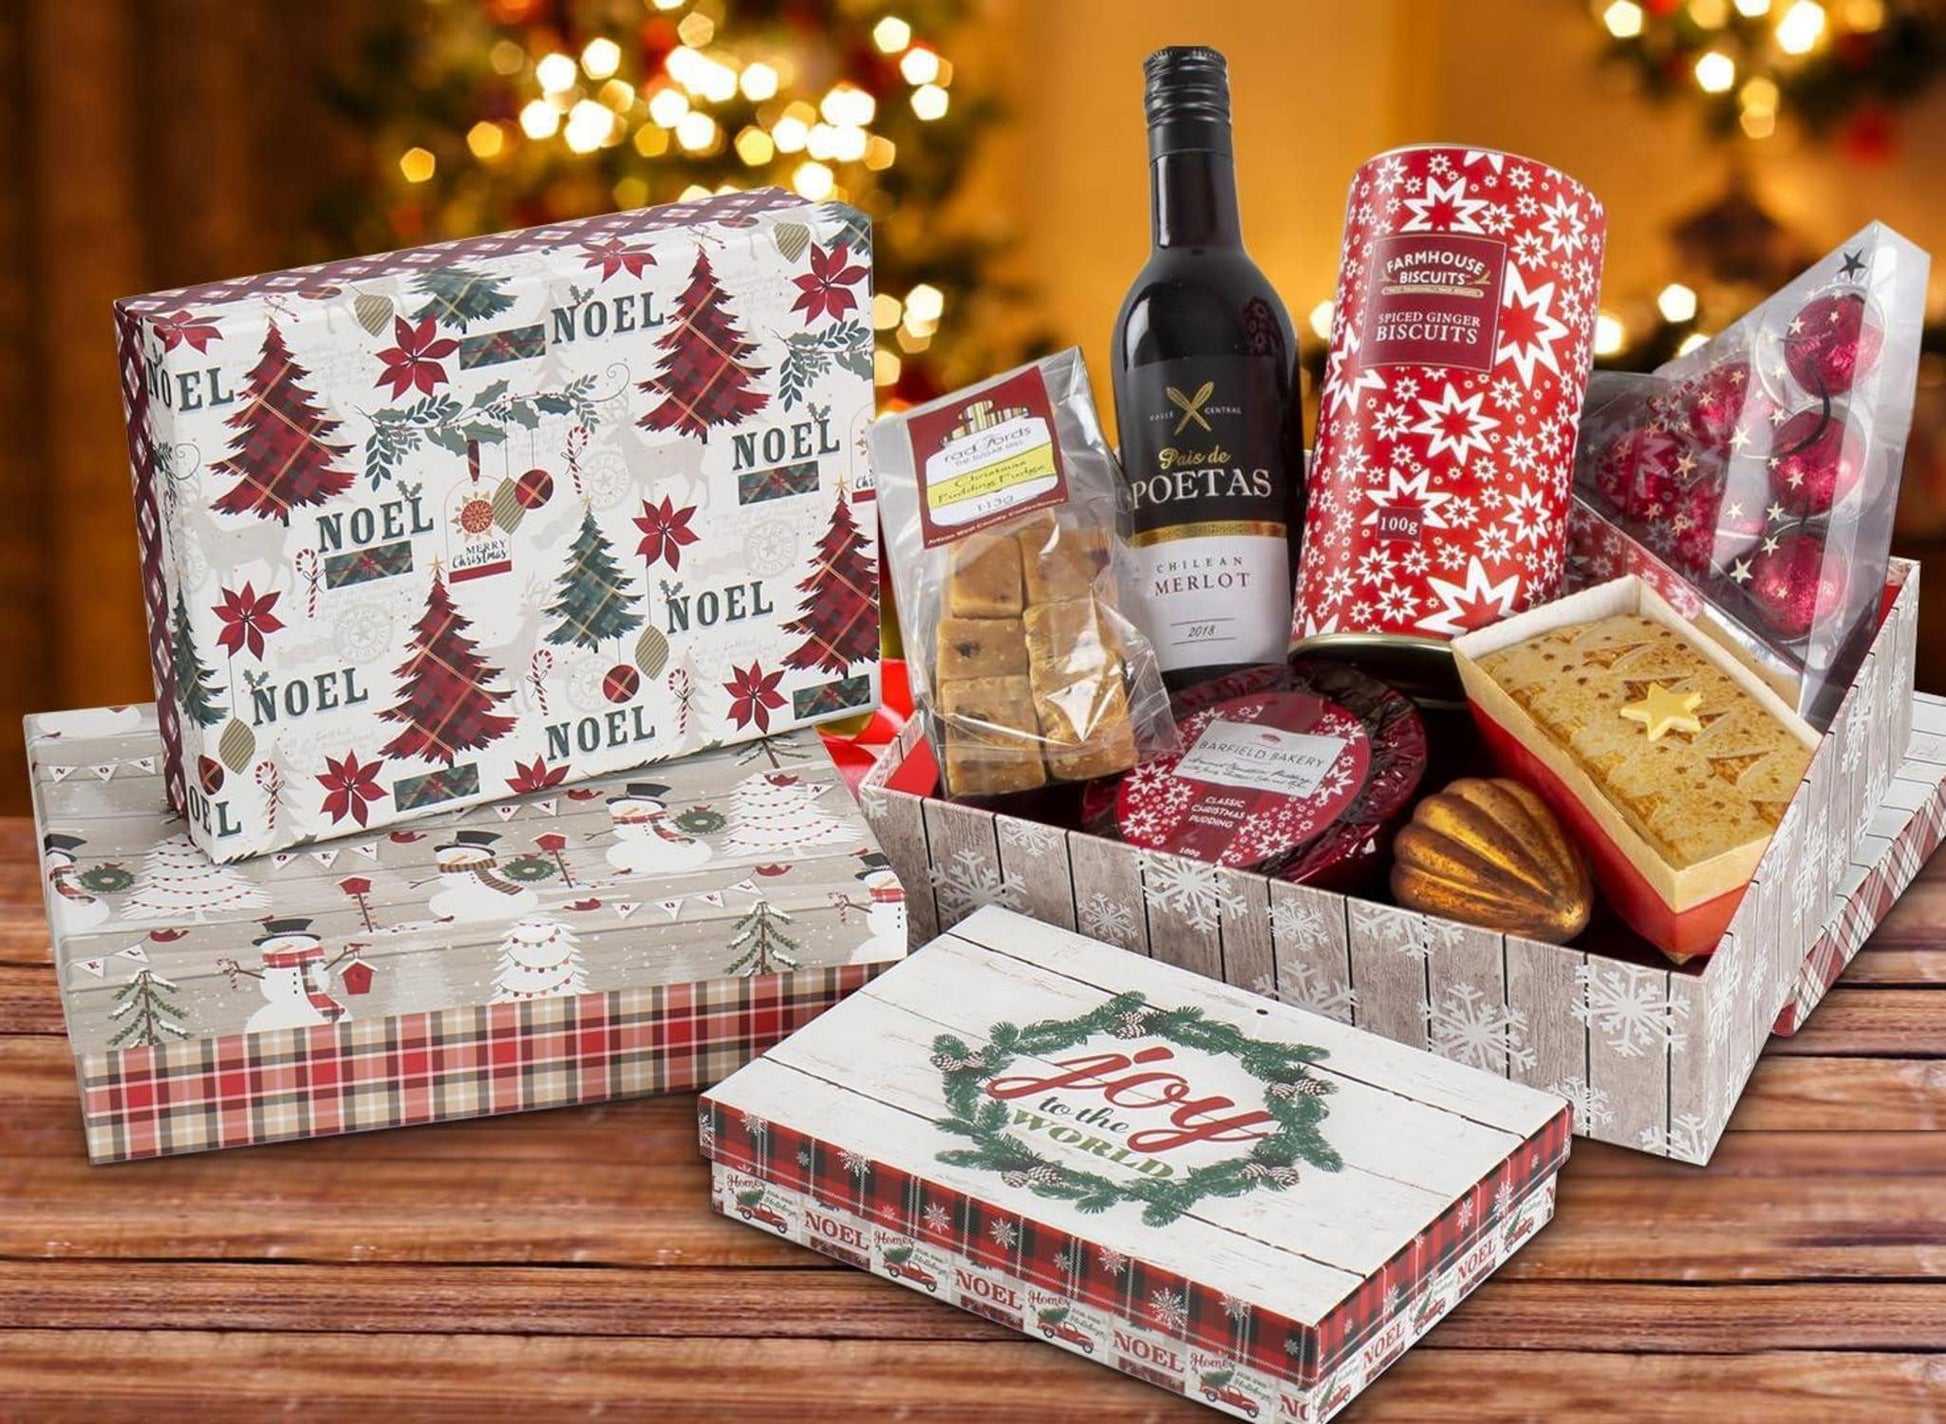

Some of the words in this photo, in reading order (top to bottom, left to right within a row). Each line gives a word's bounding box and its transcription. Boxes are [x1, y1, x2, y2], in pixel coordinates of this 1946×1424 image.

[1386, 250, 1485, 276] FARMHOUSE
[1399, 270, 1466, 286] BISCUITS
[551, 292, 665, 345] NOEL
[1375, 323, 1478, 345] BISCUITS
[1379, 311, 1424, 324] SPICED
[1426, 312, 1481, 328] GINGER
[146, 357, 235, 412] NOEL
[1204, 405, 1242, 415] CENTRAL
[732, 419, 841, 472] NOEL
[1208, 444, 1232, 464] de
[1131, 468, 1273, 510] POETAS
[316, 497, 435, 554] NOEL
[1381, 516, 1419, 536] 100g
[452, 549, 507, 569] Christmas
[465, 539, 507, 555] MERRY
[1156, 556, 1244, 574] CHILEAN
[1154, 571, 1251, 597] MERLOT
[666, 579, 774, 635] NOEL
[1188, 624, 1216, 638] 2018
[253, 667, 369, 727] NOEL
[545, 706, 656, 761] NOEL
[1199, 740, 1267, 760] BARFIELD
[1268, 751, 1326, 769] BAKERY
[189, 785, 242, 838] OEL
[1191, 804, 1247, 820] CHRISTMAS
[1205, 796, 1247, 808] CLASSIC
[1188, 814, 1235, 829] PUDDING
[1038, 1094, 1072, 1117] to
[1071, 1105, 1130, 1135] the
[1010, 1107, 1175, 1180] WORLD
[804, 1210, 870, 1251] NOEL
[1458, 1239, 1497, 1280] NOEL
[954, 1268, 1023, 1311] NOEL
[1113, 1329, 1185, 1374] NOEL
[1363, 1322, 1406, 1366] NOEL
